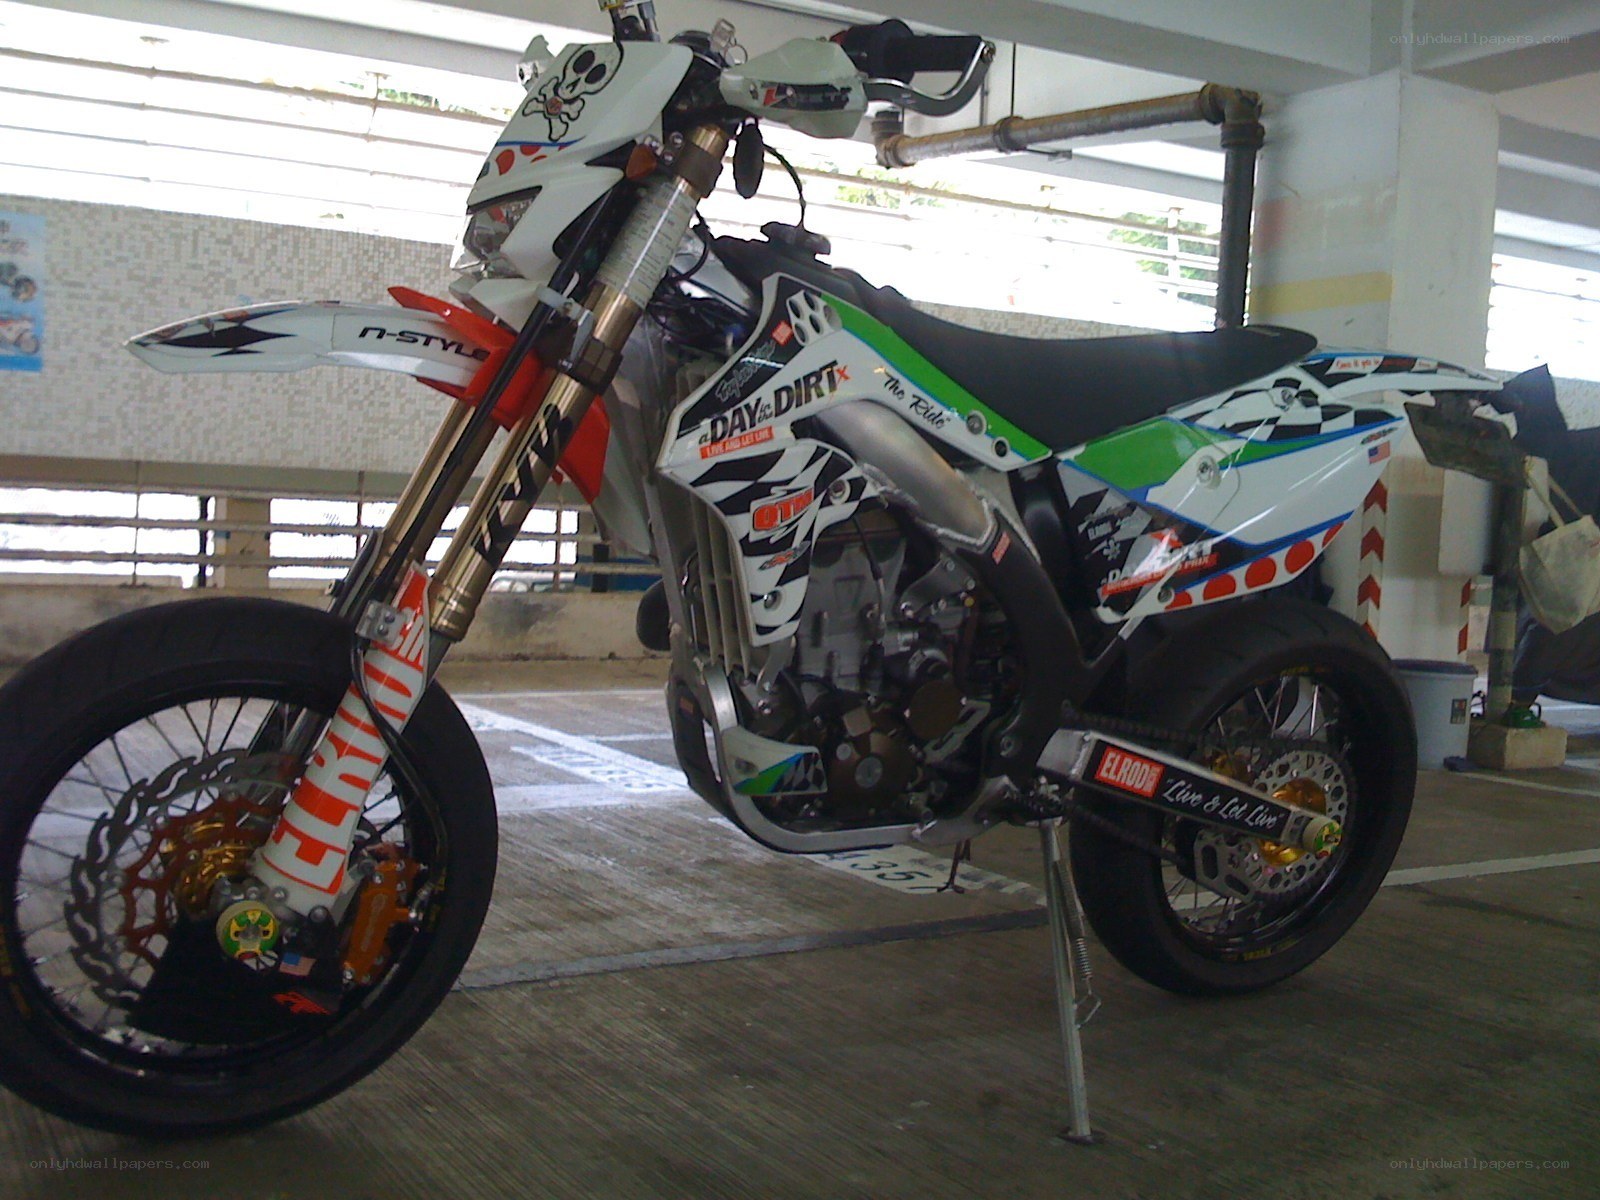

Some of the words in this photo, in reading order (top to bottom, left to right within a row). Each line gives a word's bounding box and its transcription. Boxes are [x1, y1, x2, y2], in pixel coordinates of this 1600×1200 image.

[710, 397, 762, 444] DAY
[774, 360, 838, 418] DIRT
[1203, 795, 1218, 814] &
[1218, 798, 1247, 820] Let
